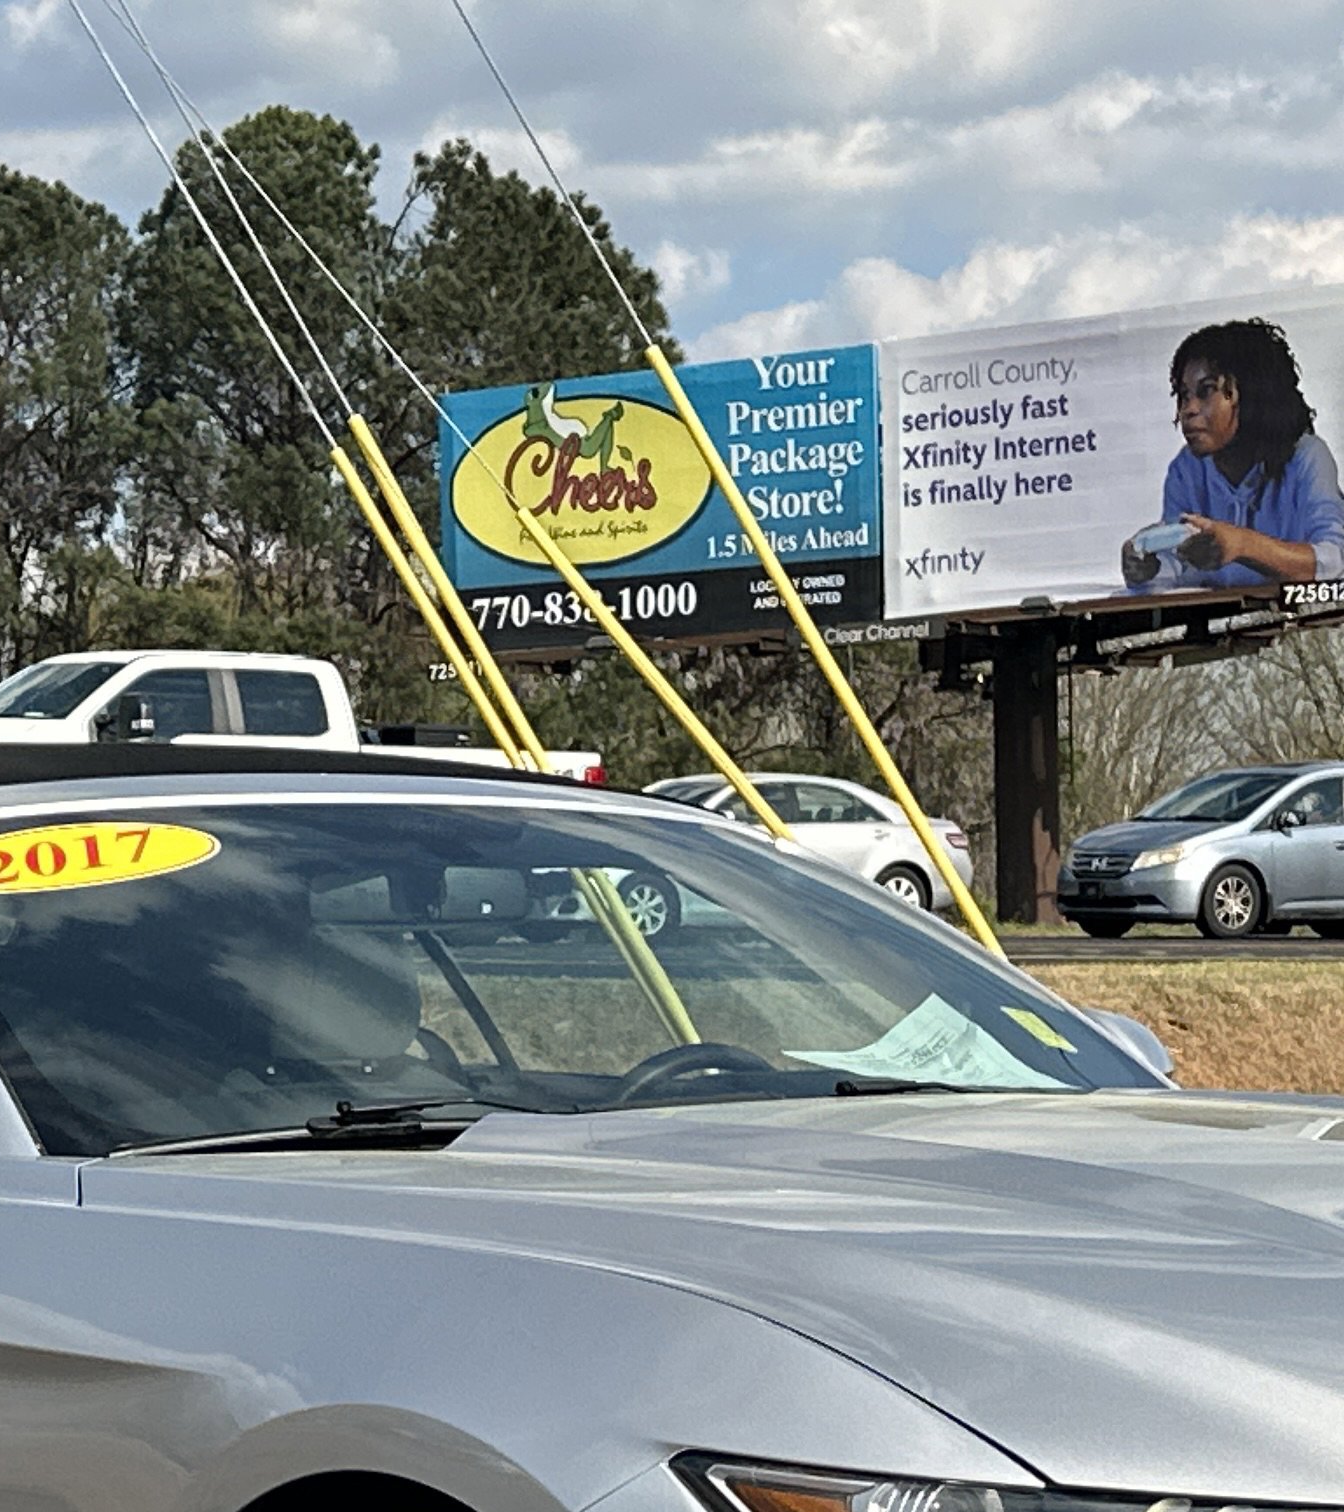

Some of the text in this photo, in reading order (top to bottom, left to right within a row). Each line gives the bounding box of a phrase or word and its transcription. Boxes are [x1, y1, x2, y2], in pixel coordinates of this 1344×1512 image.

[752, 355, 835, 390] Your
[901, 357, 1078, 396] Carroll County,
[726, 391, 864, 435] Premier
[902, 394, 1069, 433] seriously fast
[727, 437, 865, 478] Package
[902, 429, 1097, 470] Xfinity Internet
[747, 478, 844, 520] Store!
[903, 471, 1073, 508] is finally here
[707, 533, 738, 559] 1.5
[801, 522, 869, 549] Ahead
[905, 546, 986, 580] xfinity
[749, 577, 801, 593] LOCY
[824, 621, 930, 645] Clear Channel
